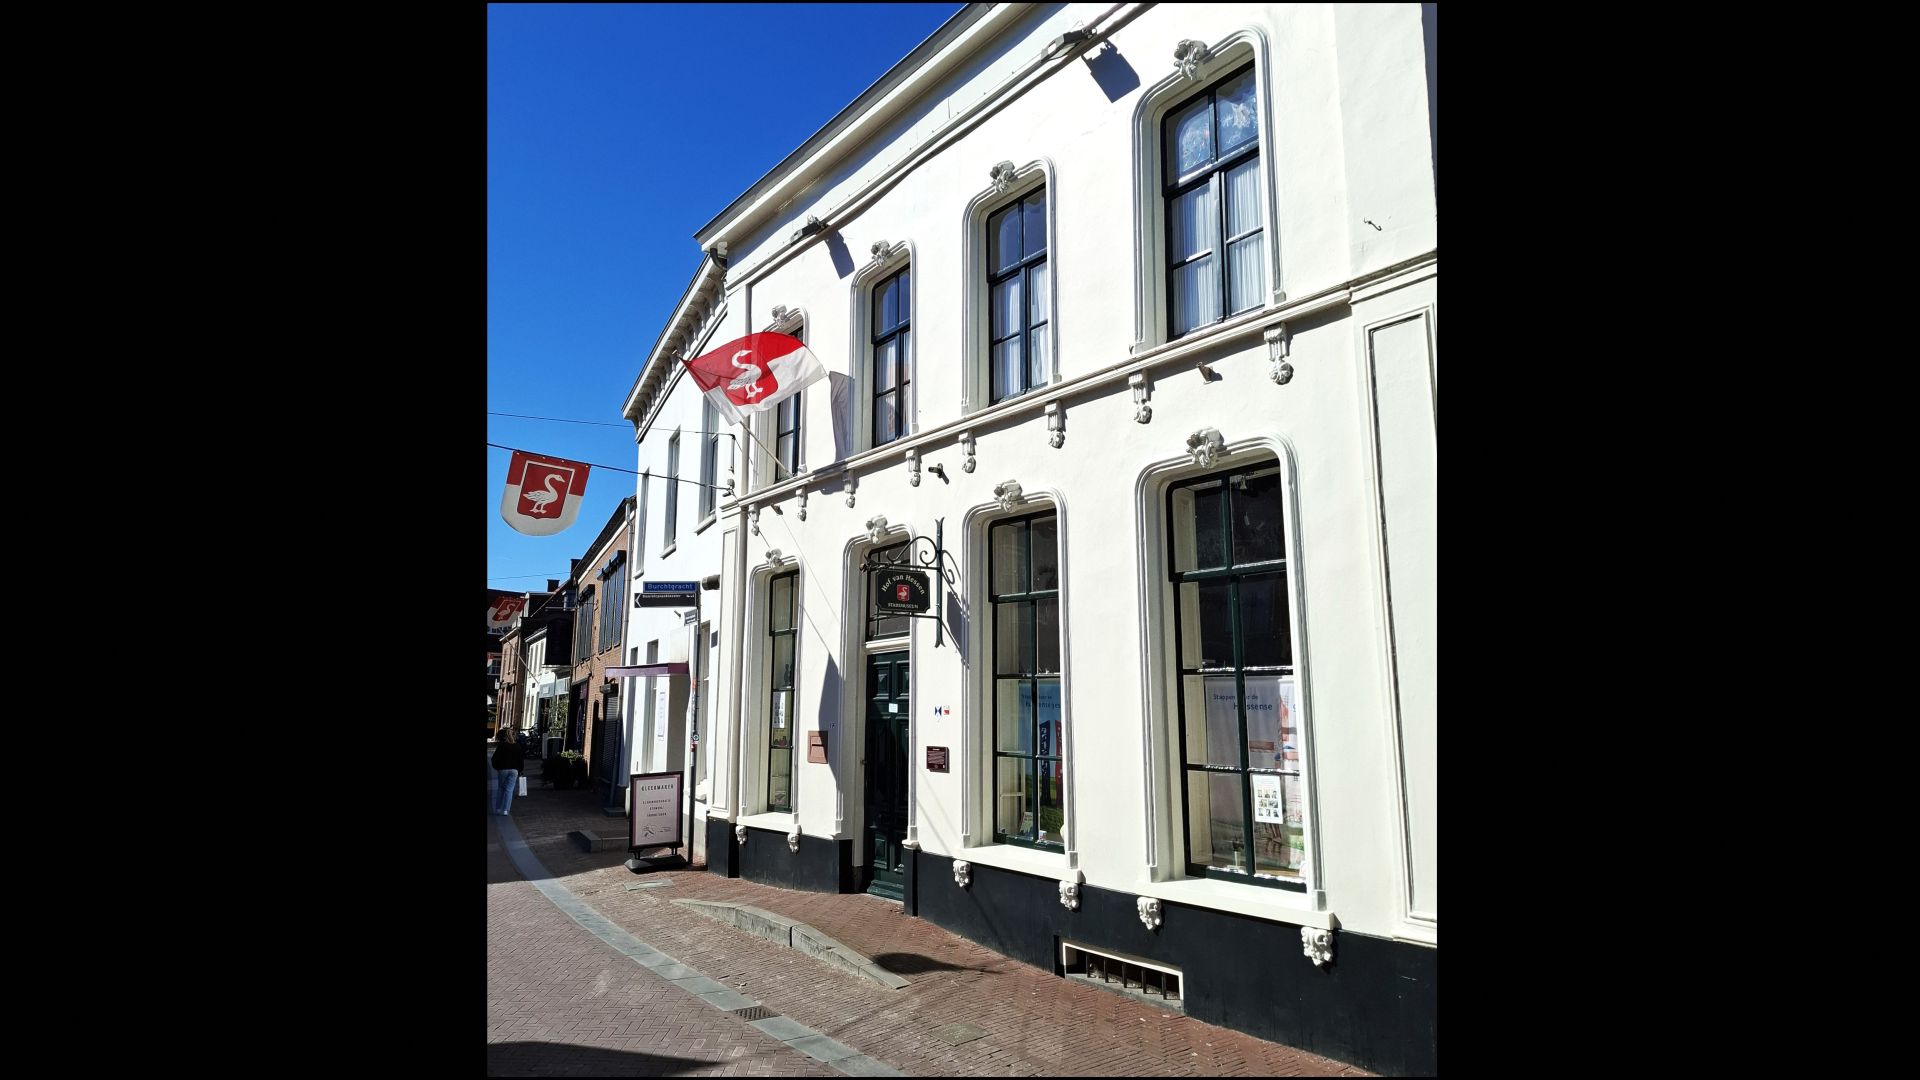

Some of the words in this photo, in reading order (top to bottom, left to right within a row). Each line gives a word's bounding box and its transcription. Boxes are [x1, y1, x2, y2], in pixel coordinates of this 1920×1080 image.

[881, 577, 892, 592] Hof
[892, 574, 904, 582] van
[905, 574, 925, 595] Hessen
[1233, 702, 1273, 711] Hssense
